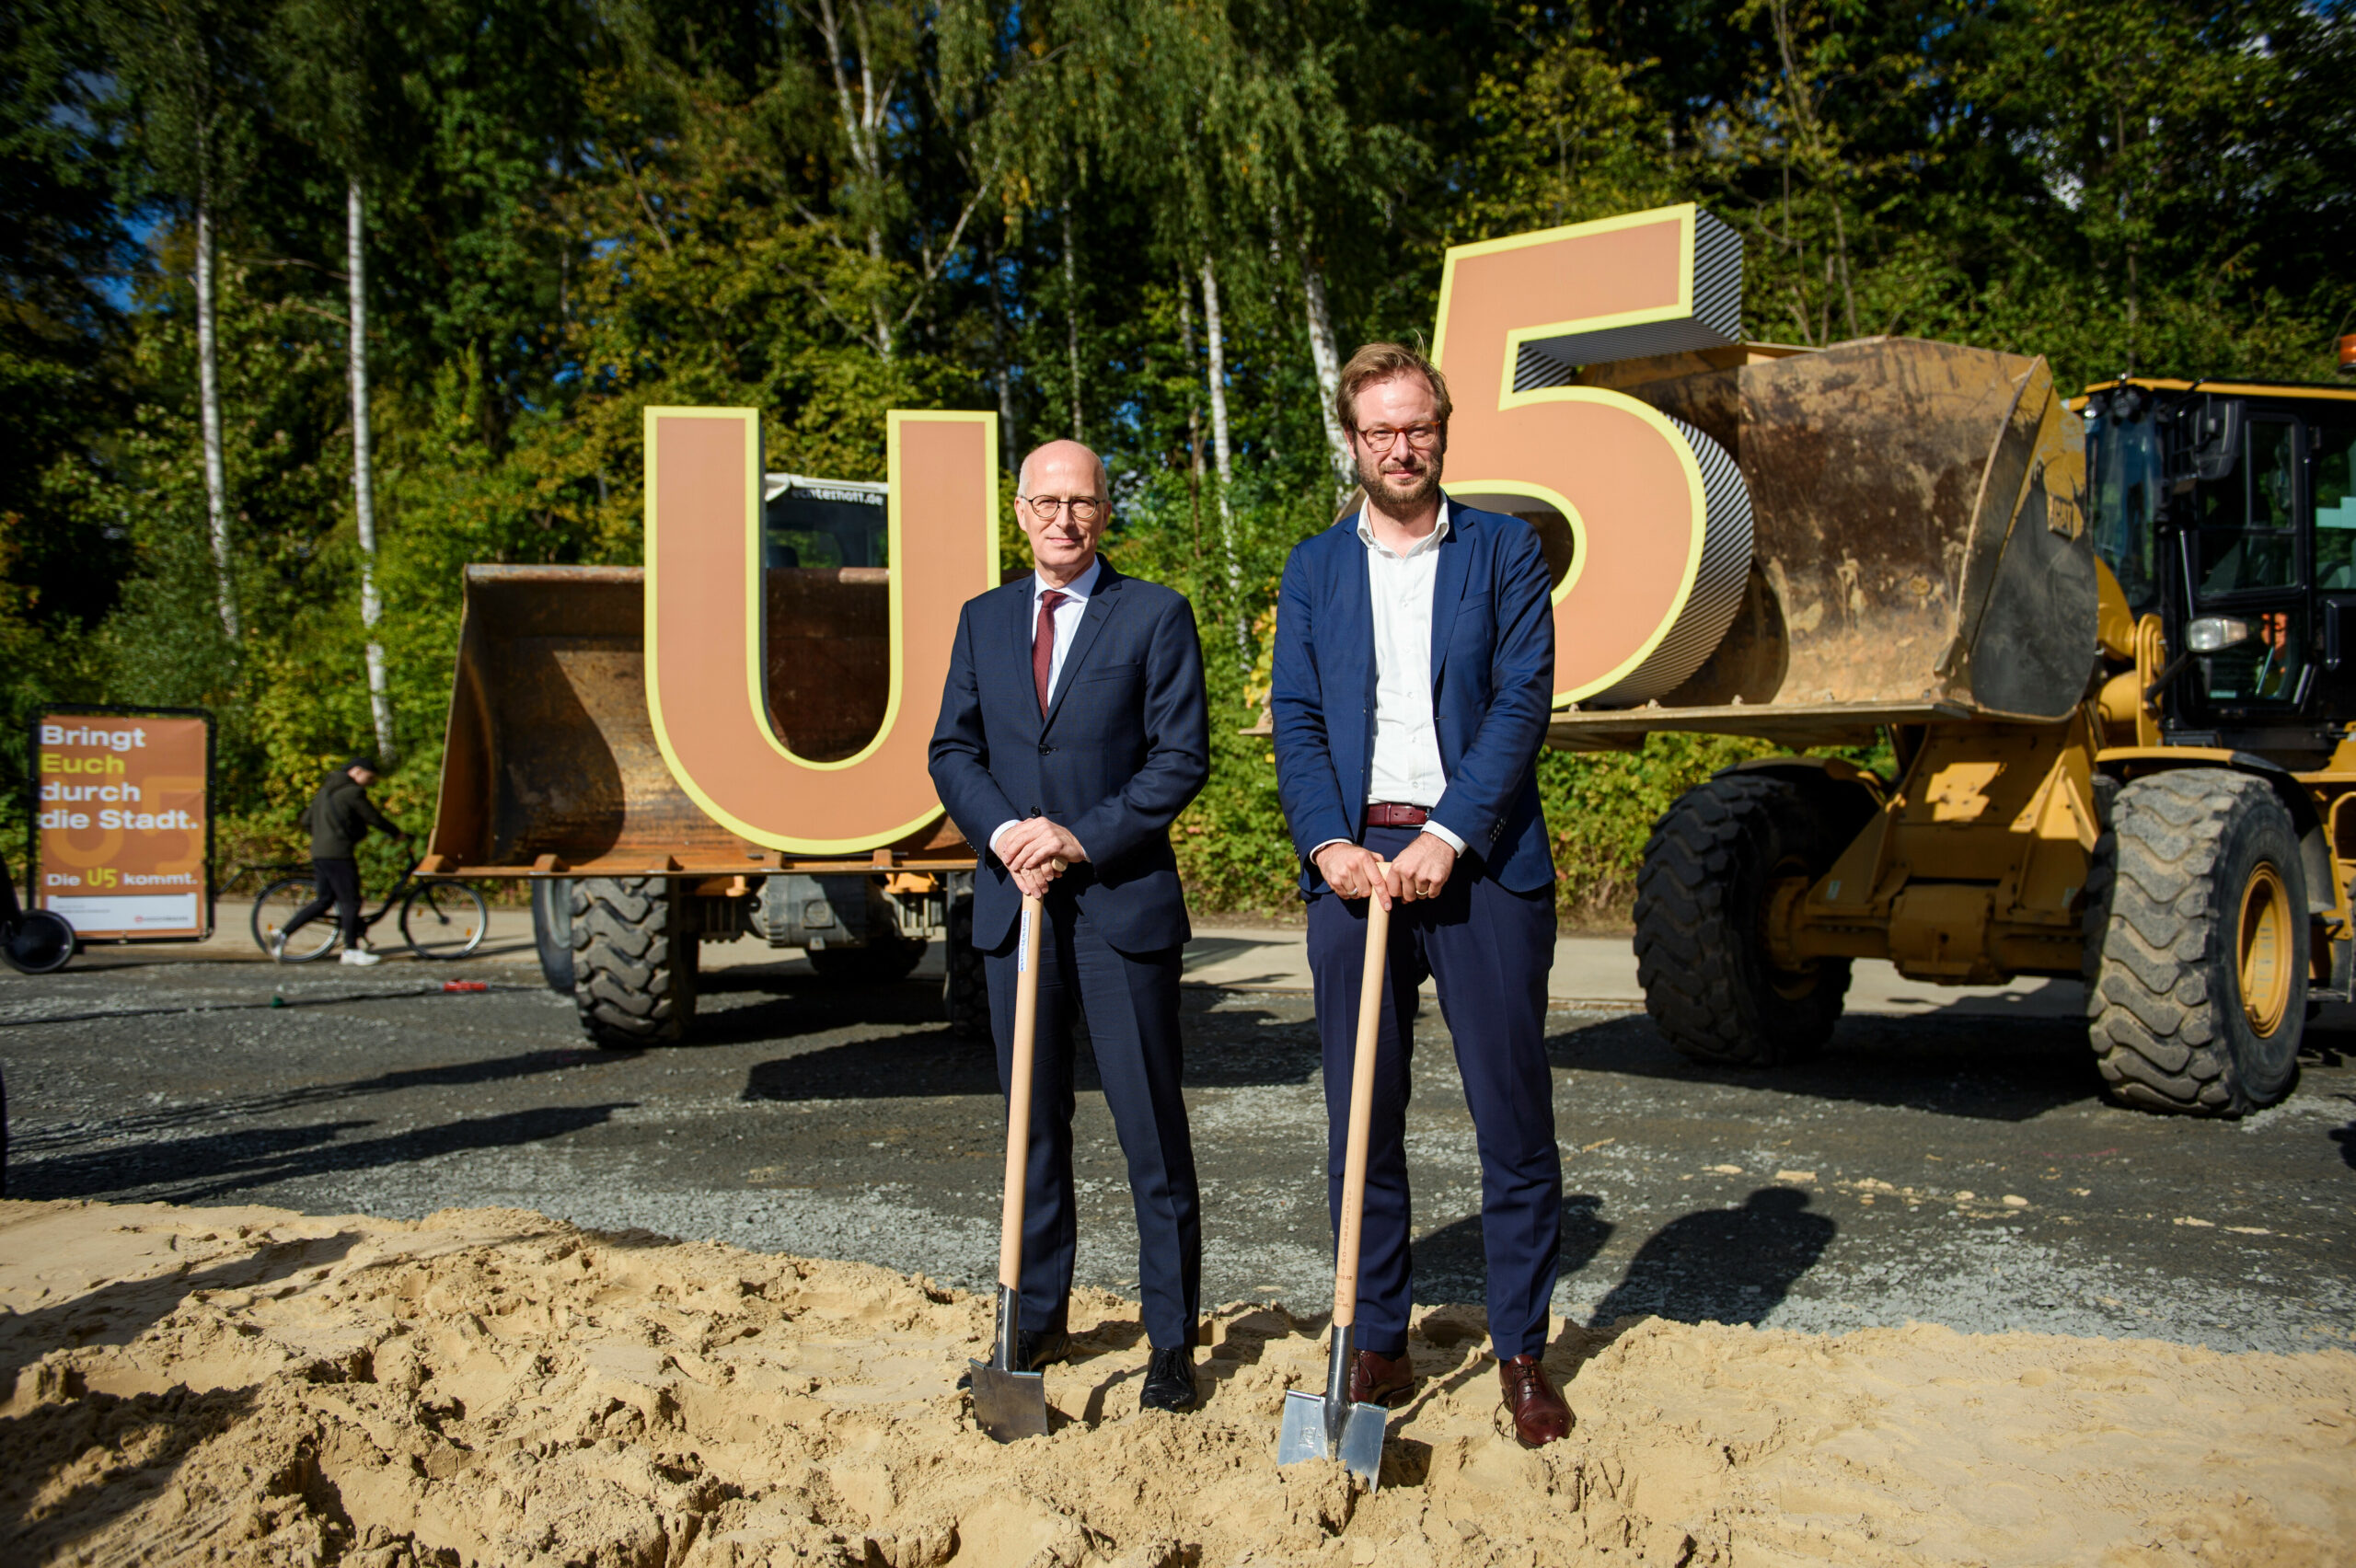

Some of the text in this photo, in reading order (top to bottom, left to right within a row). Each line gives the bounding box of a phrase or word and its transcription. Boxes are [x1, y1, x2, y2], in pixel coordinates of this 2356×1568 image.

[1430, 202, 1708, 709] 5
[643, 405, 1000, 856] U
[40, 725, 147, 752] Bringt
[40, 753, 126, 775] Euch
[41, 781, 141, 801] durch
[40, 809, 199, 830] die Stadt.
[47, 867, 198, 889] Die U5 kommt.
